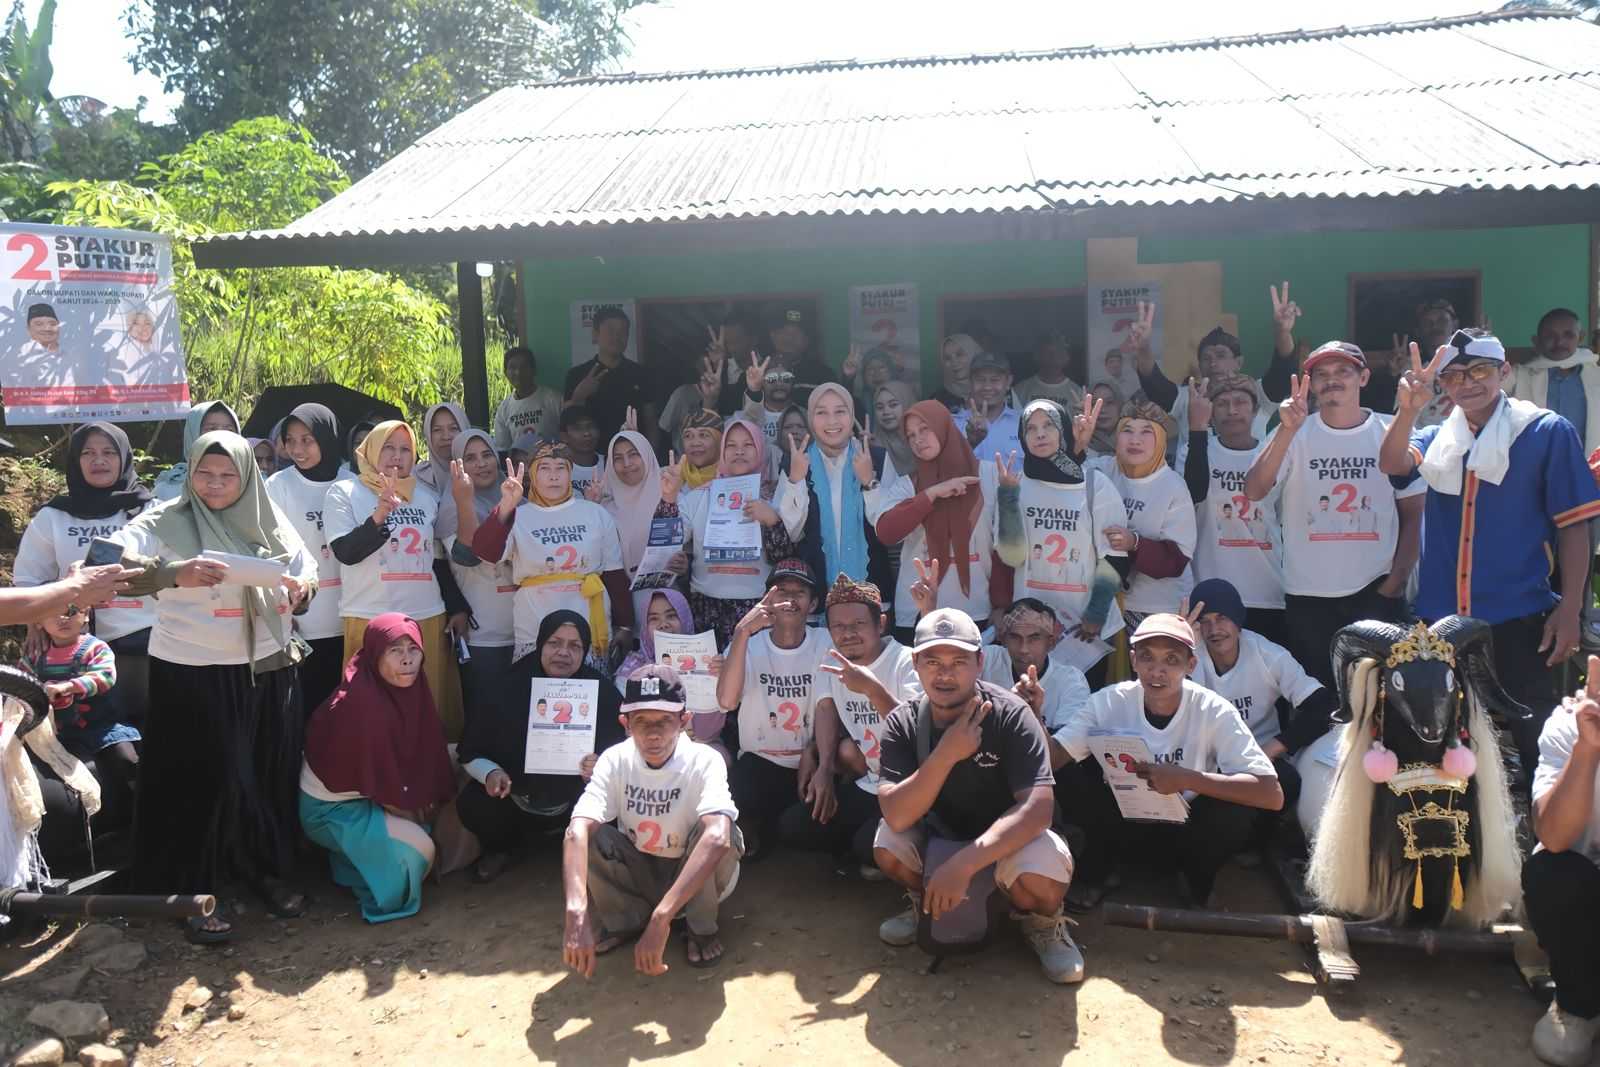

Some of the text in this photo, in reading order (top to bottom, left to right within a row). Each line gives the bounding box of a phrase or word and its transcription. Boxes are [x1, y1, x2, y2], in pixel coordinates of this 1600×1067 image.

[55, 235, 155, 257] SYAKUR
[6, 232, 52, 280] 2
[57, 252, 131, 271] PUTRI
[1101, 287, 1151, 298] SYAKUR
[1309, 456, 1377, 470] SYAKUR
[1211, 468, 1248, 481] SYAK
[1318, 468, 1368, 481] PUTRI
[1331, 483, 1358, 513] 2
[531, 524, 588, 538] SYAKUR
[1034, 518, 1077, 532] PUTRI
[399, 527, 422, 555] 2
[541, 533, 583, 545] PUTRI
[1044, 532, 1069, 565] 2
[554, 544, 577, 571] 2
[759, 673, 813, 687] SYAKUR
[767, 685, 807, 698] PUTRI
[552, 700, 573, 724] 2
[777, 702, 801, 732] 2
[863, 728, 881, 759] 2
[626, 799, 672, 817] PUTRI
[637, 820, 665, 852] 2
